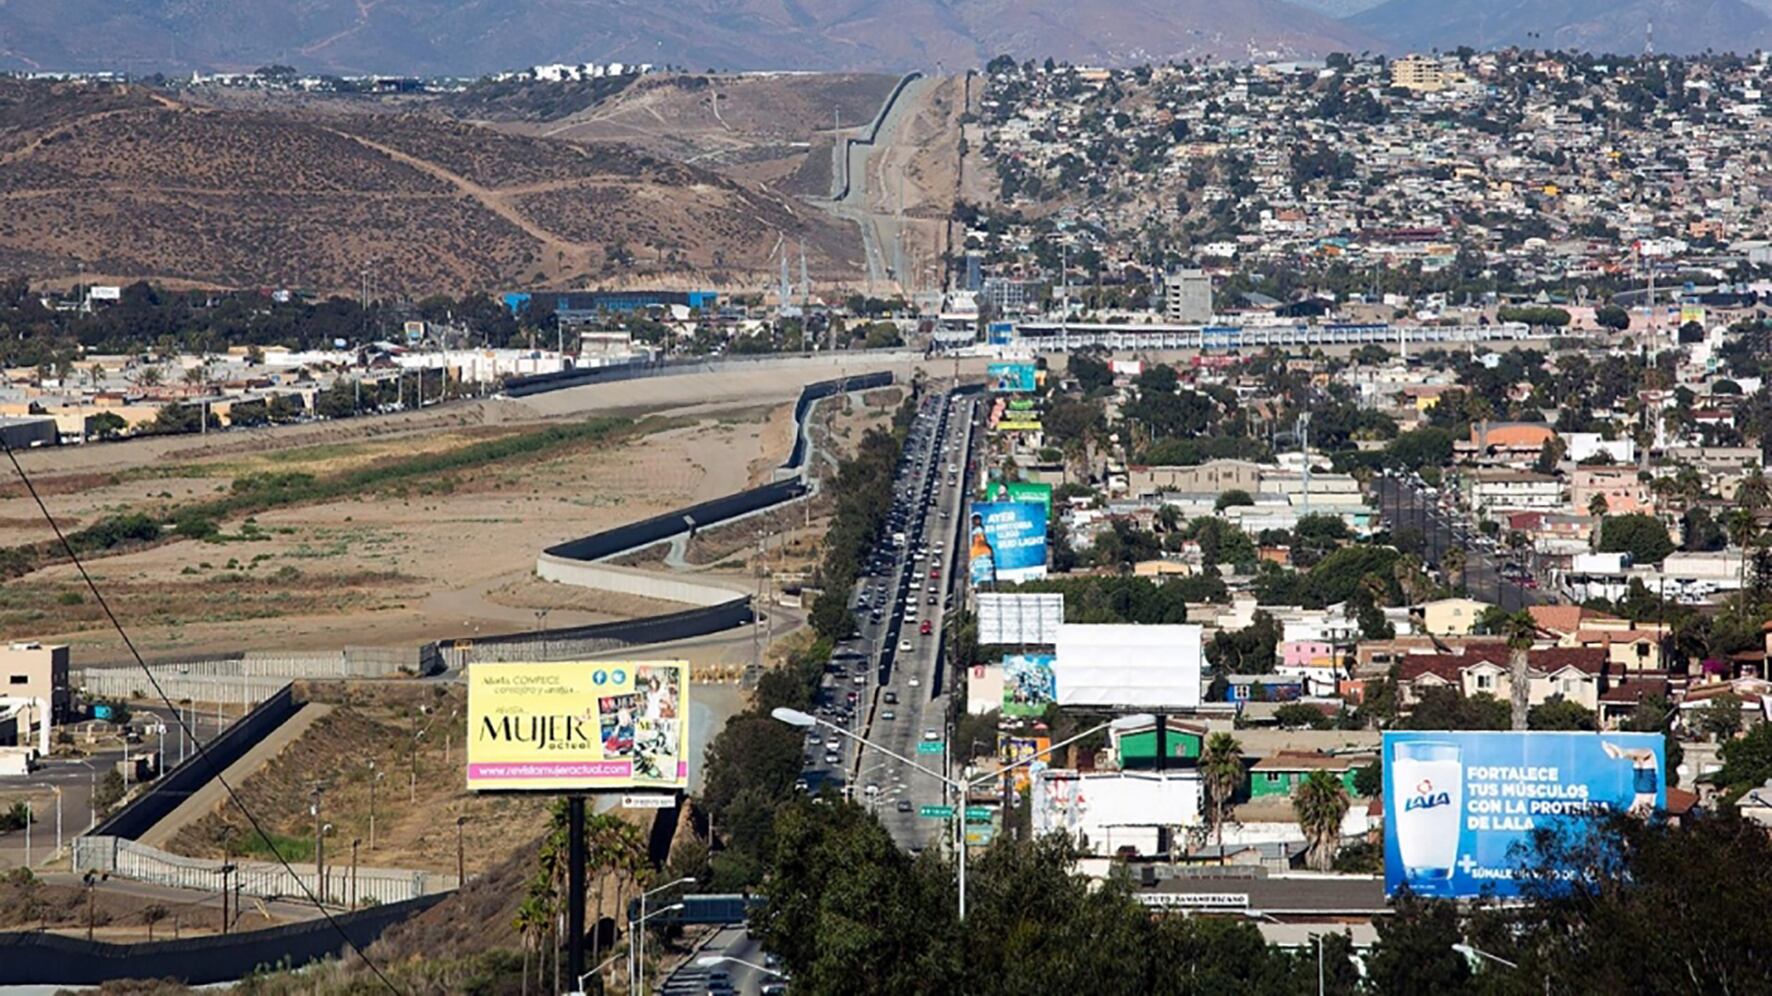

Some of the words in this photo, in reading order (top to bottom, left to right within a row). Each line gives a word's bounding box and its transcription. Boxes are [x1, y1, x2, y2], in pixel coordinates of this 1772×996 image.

[480, 715, 589, 750] MUJER
[1467, 766, 1558, 781] FORTALECE
[1467, 783, 1499, 797] TUS
[1502, 781, 1589, 798] MÚSCULOS
[1405, 792, 1450, 813] LALA
[1467, 800, 1502, 813] CON
[1505, 801, 1527, 814] LA
[1467, 816, 1490, 830] DE
[1493, 817, 1535, 830] LALA
